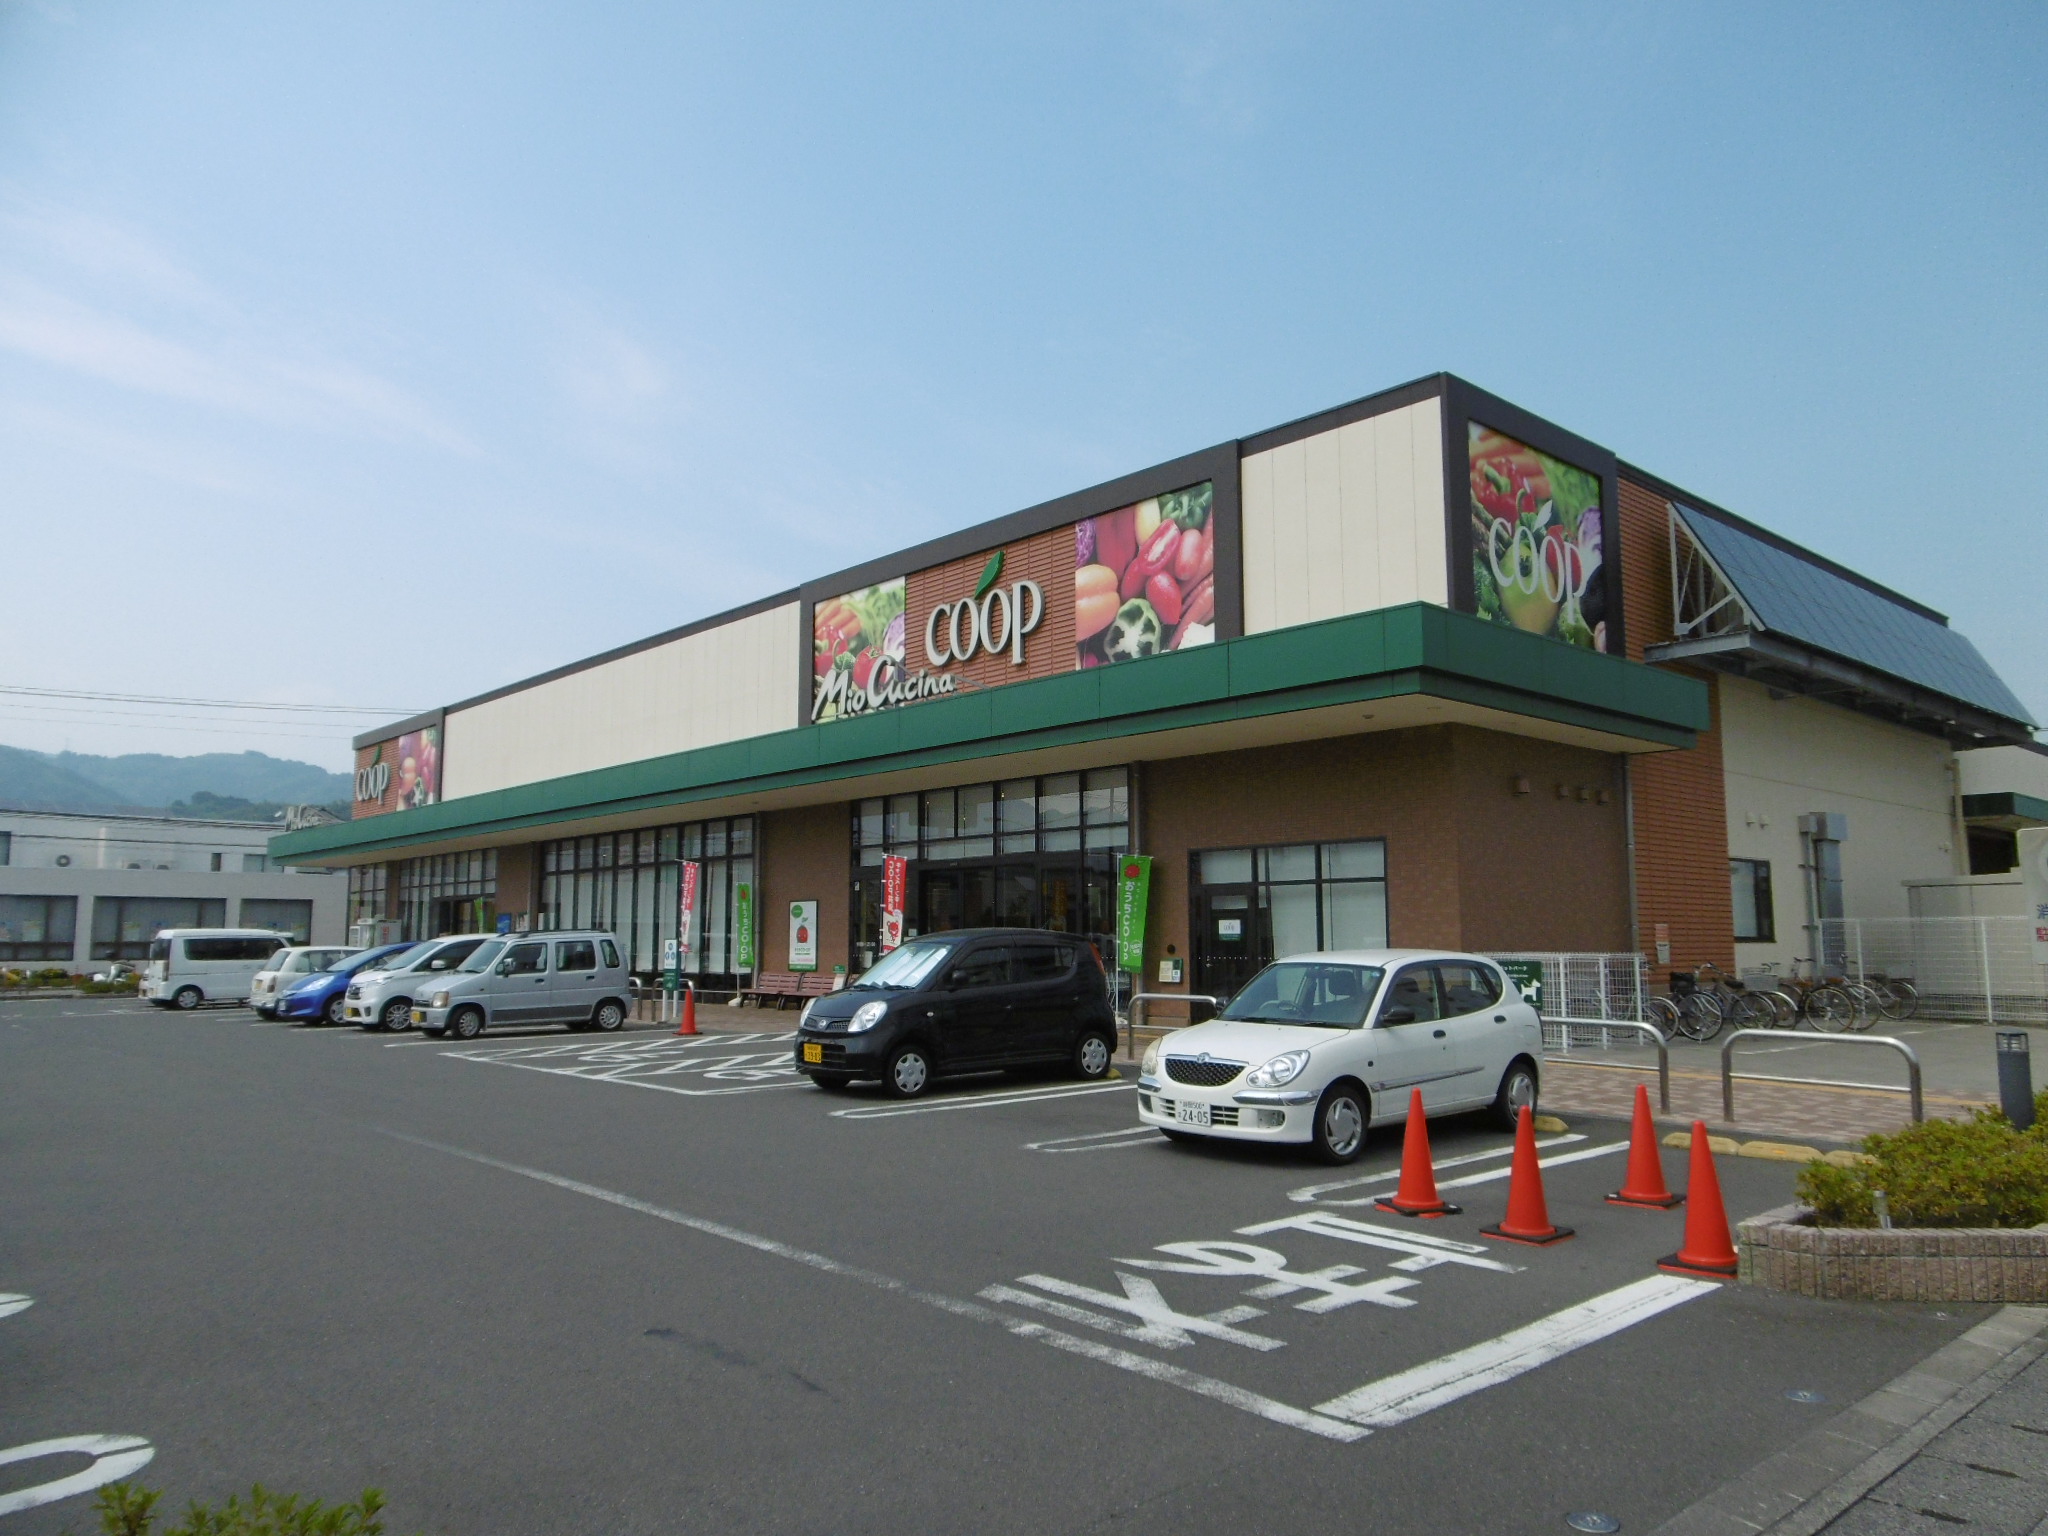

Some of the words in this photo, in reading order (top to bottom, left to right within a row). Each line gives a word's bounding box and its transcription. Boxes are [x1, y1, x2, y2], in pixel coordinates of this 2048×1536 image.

[812, 669, 865, 721] Mio
[866, 654, 957, 709] Cucina
[975, 1210, 1525, 1352] 止まれ
